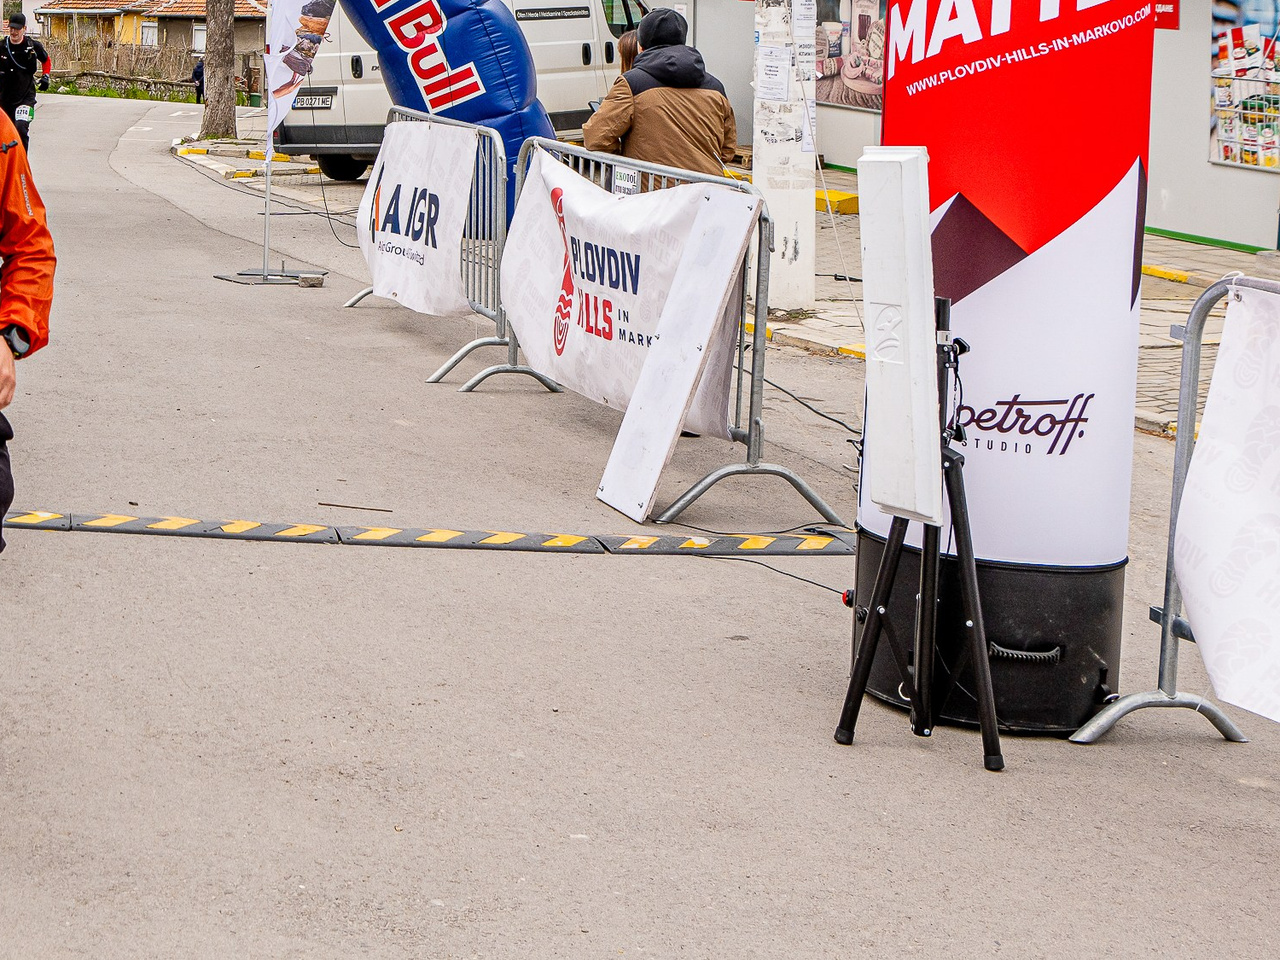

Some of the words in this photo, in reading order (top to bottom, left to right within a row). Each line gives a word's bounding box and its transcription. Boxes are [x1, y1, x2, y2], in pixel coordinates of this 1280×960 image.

[906, 3, 1152, 97] WWW.PLOVDIV-HILLS-IN-MARKOVO.COM
[570, 235, 641, 296] PLOVDIV
[618, 308, 630, 324] IN
[618, 328, 653, 348] MARK
